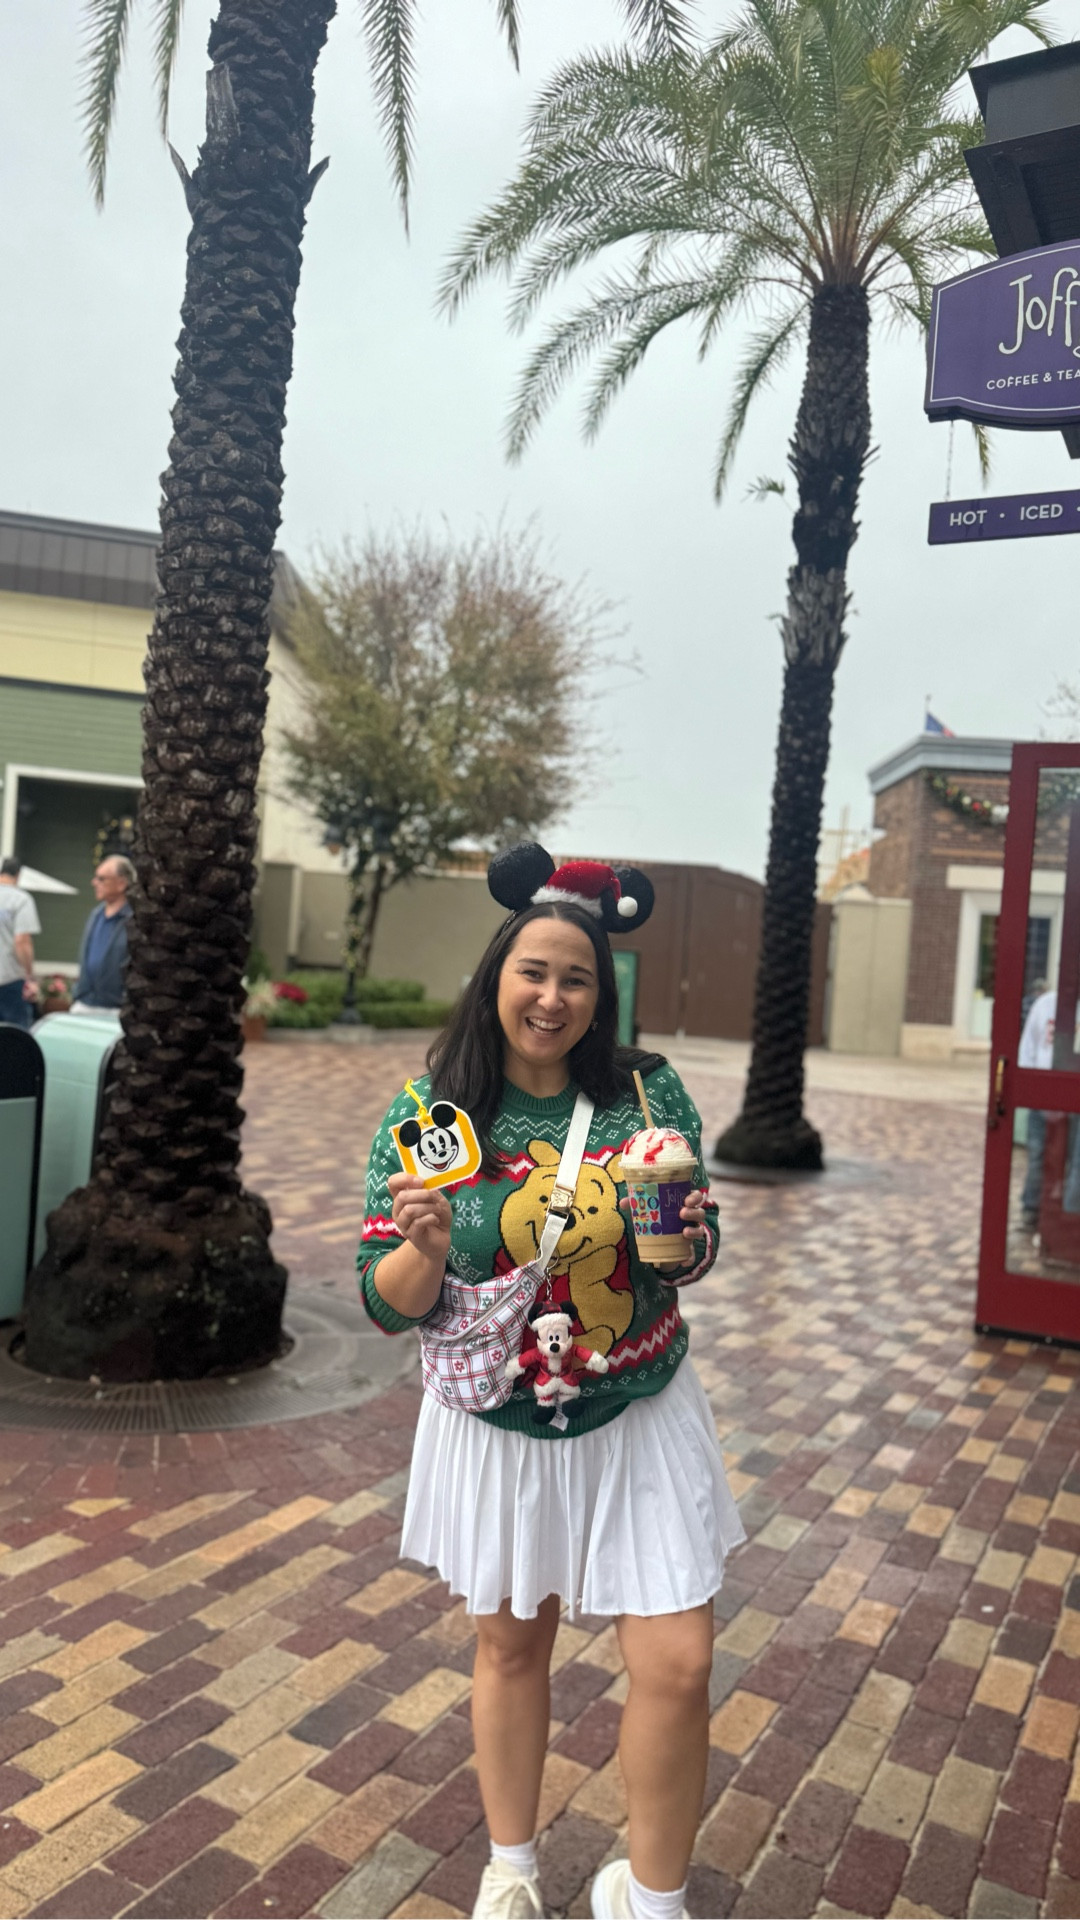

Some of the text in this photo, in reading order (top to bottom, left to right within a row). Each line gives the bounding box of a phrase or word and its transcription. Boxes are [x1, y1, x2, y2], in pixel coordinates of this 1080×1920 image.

[999, 267, 1080, 357] Joff
[986, 369, 1080, 390] COFFEE & TEA
[950, 503, 1064, 526] HOT ICED
